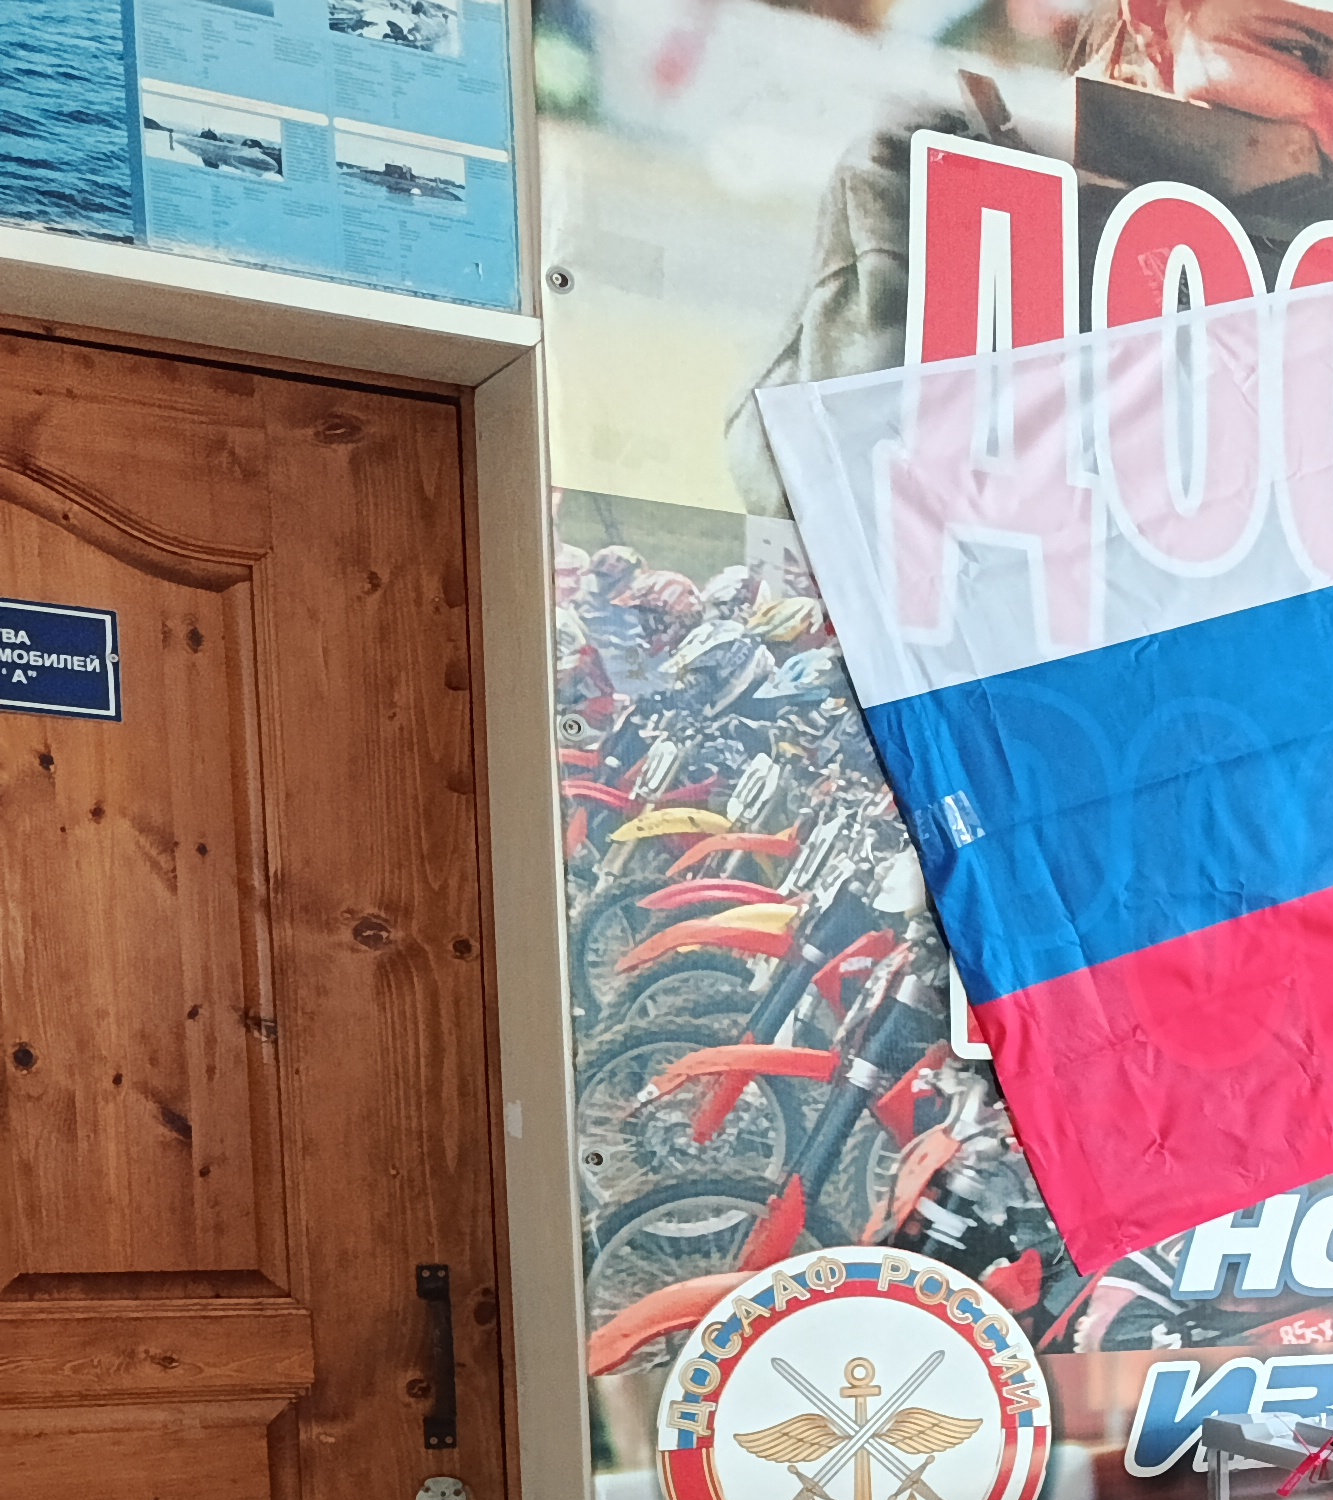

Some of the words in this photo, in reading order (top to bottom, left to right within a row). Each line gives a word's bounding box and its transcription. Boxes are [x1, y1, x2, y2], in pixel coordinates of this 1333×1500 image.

[0, 628, 31, 646] ВА
[666, 1254, 847, 1437] ДОСААФ
[876, 1253, 1042, 1416] РОССИИ
